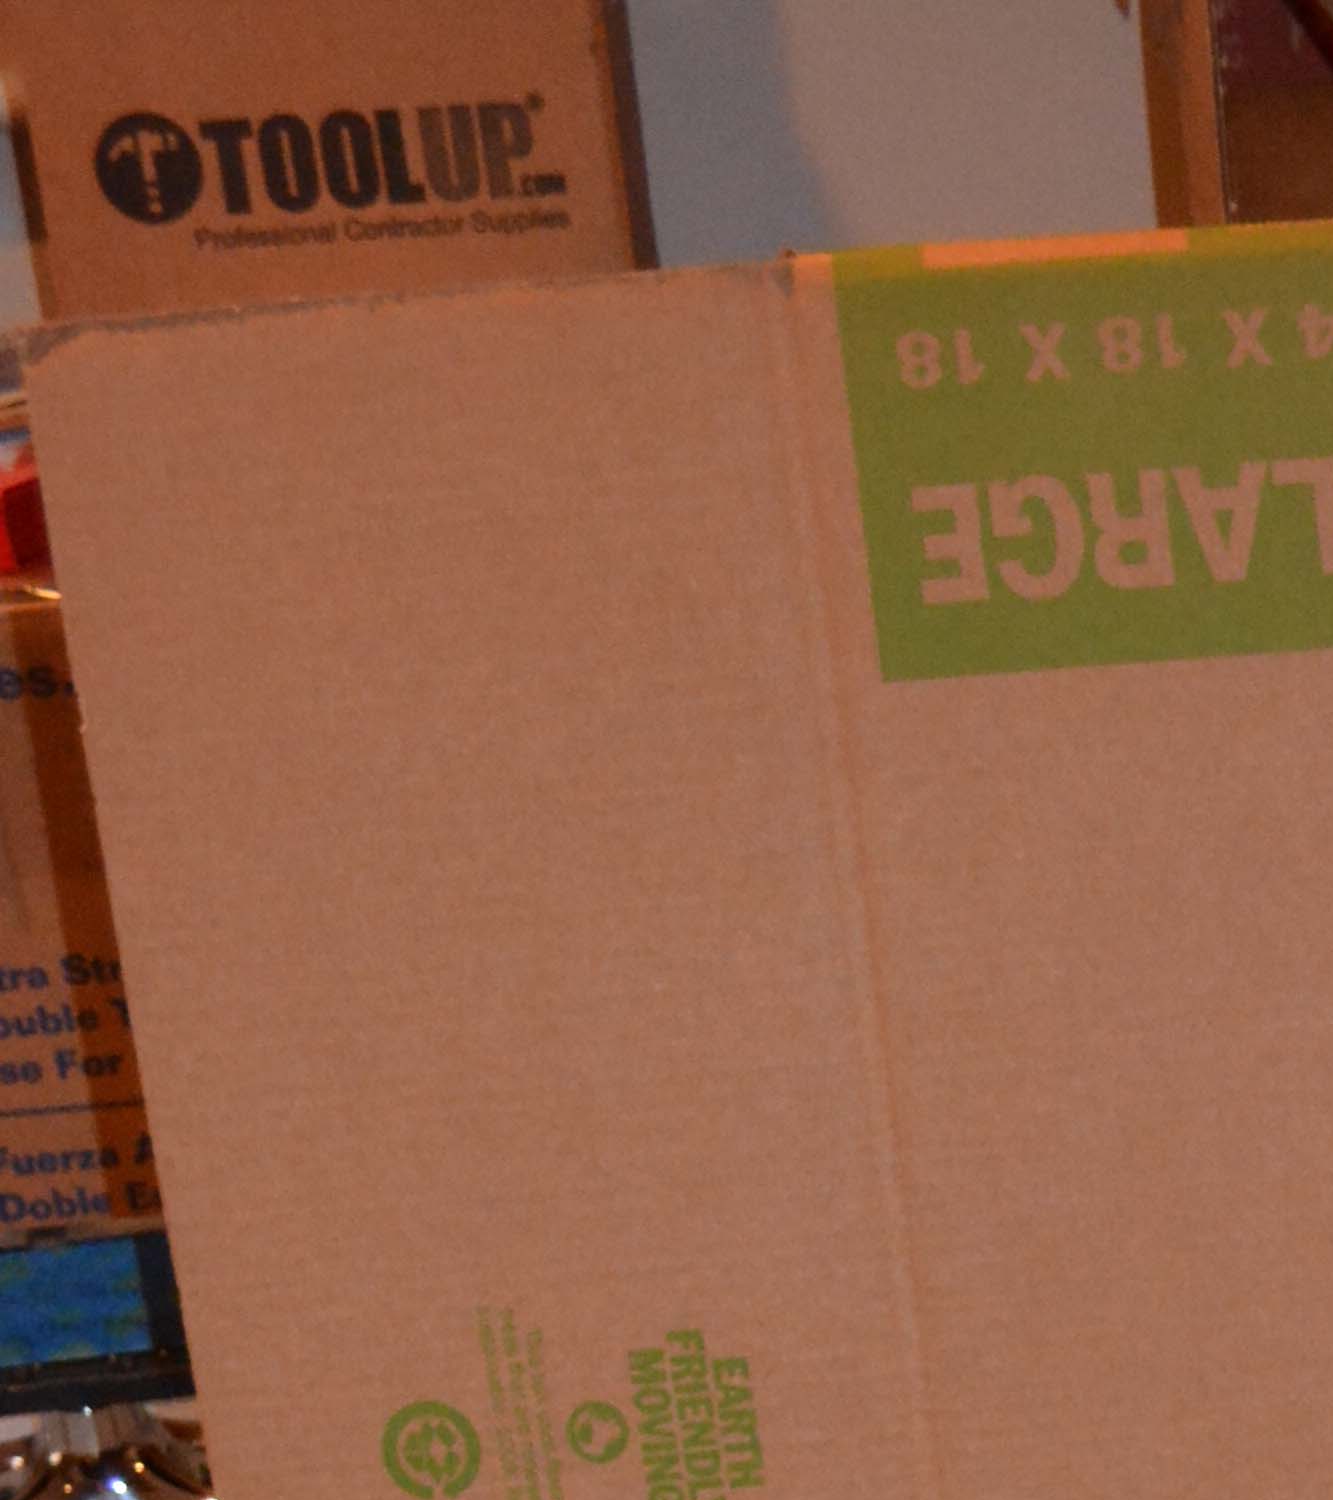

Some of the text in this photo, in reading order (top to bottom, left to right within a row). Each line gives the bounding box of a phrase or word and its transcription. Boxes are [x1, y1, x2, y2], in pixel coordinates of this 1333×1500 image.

[896, 328, 982, 389] 18
[1022, 323, 1068, 383] X
[1097, 311, 1180, 372] 18
[1227, 307, 1273, 366] X
[711, 1356, 765, 1489] EARTH
